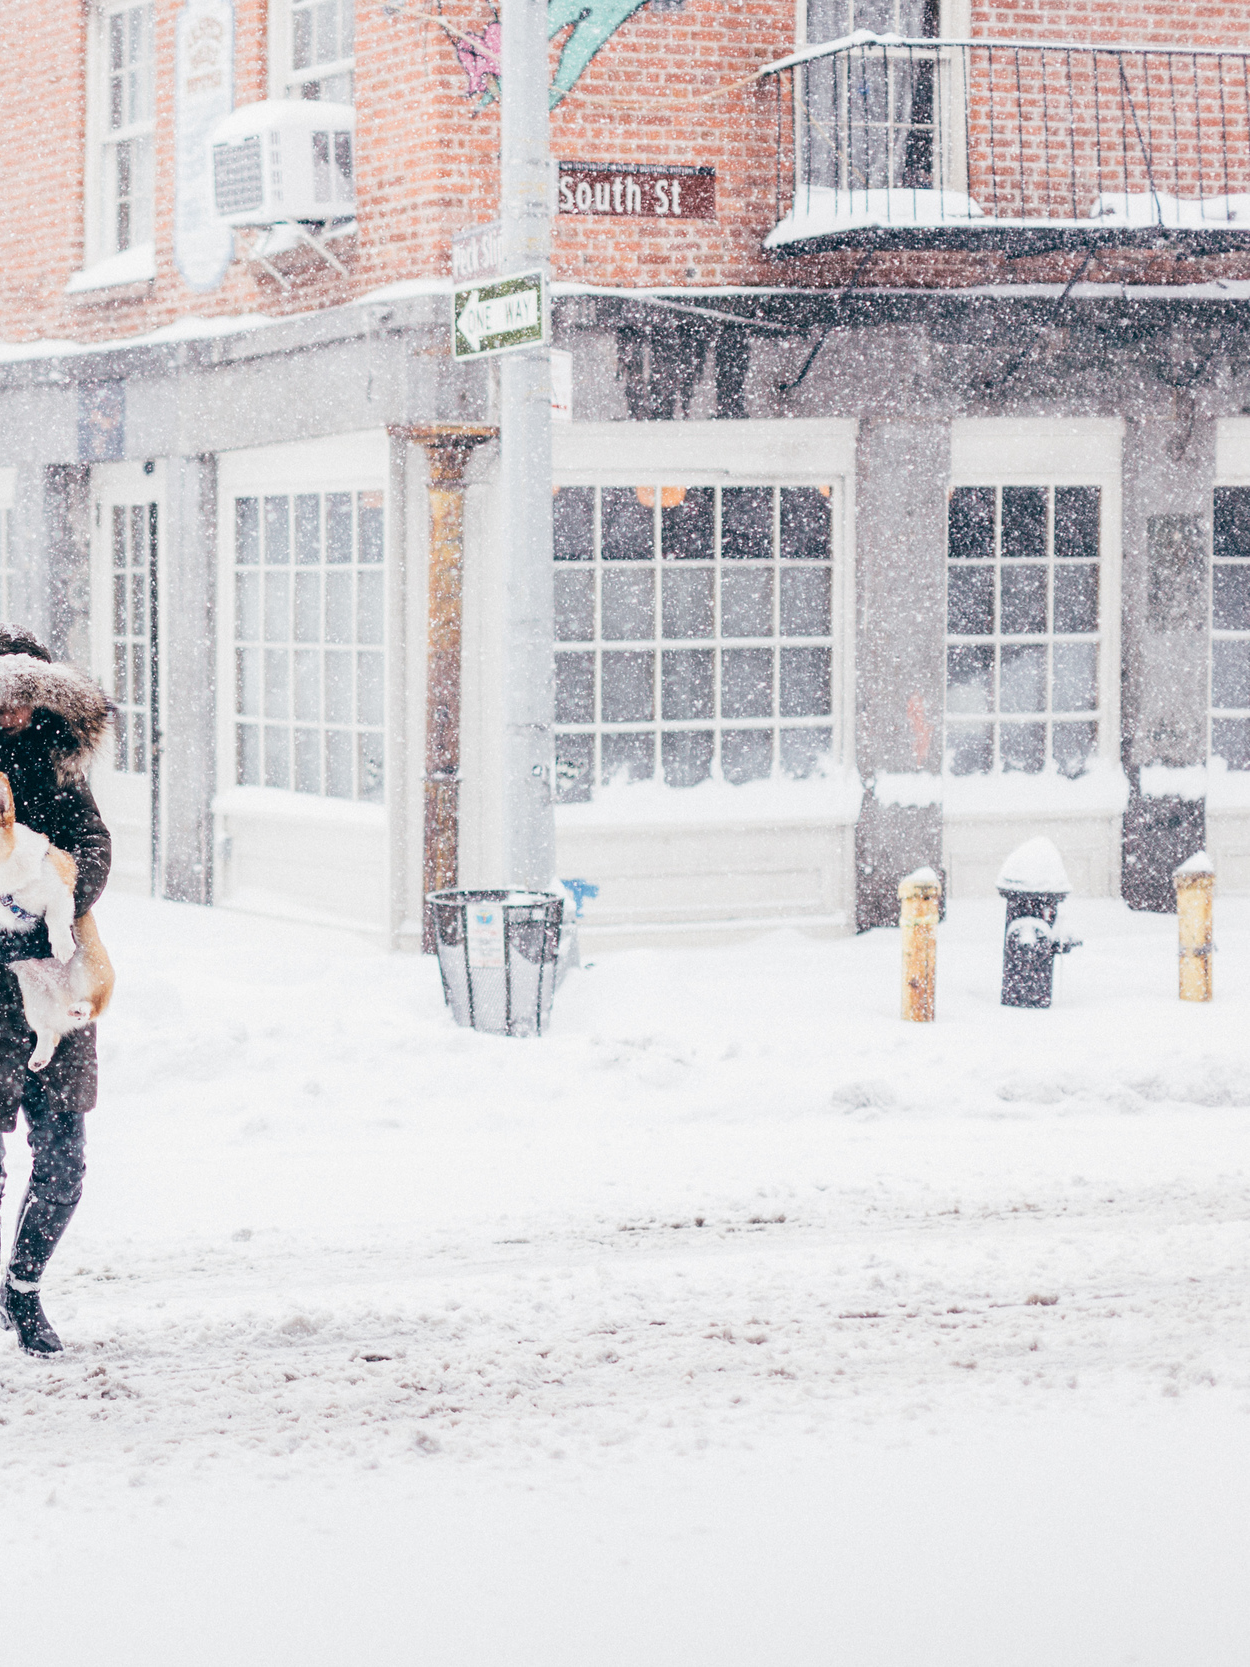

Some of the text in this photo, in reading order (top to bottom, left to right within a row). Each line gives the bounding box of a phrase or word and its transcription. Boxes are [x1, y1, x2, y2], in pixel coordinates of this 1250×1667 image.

[560, 176, 682, 215] South St
[468, 296, 531, 335] ONE WAY
